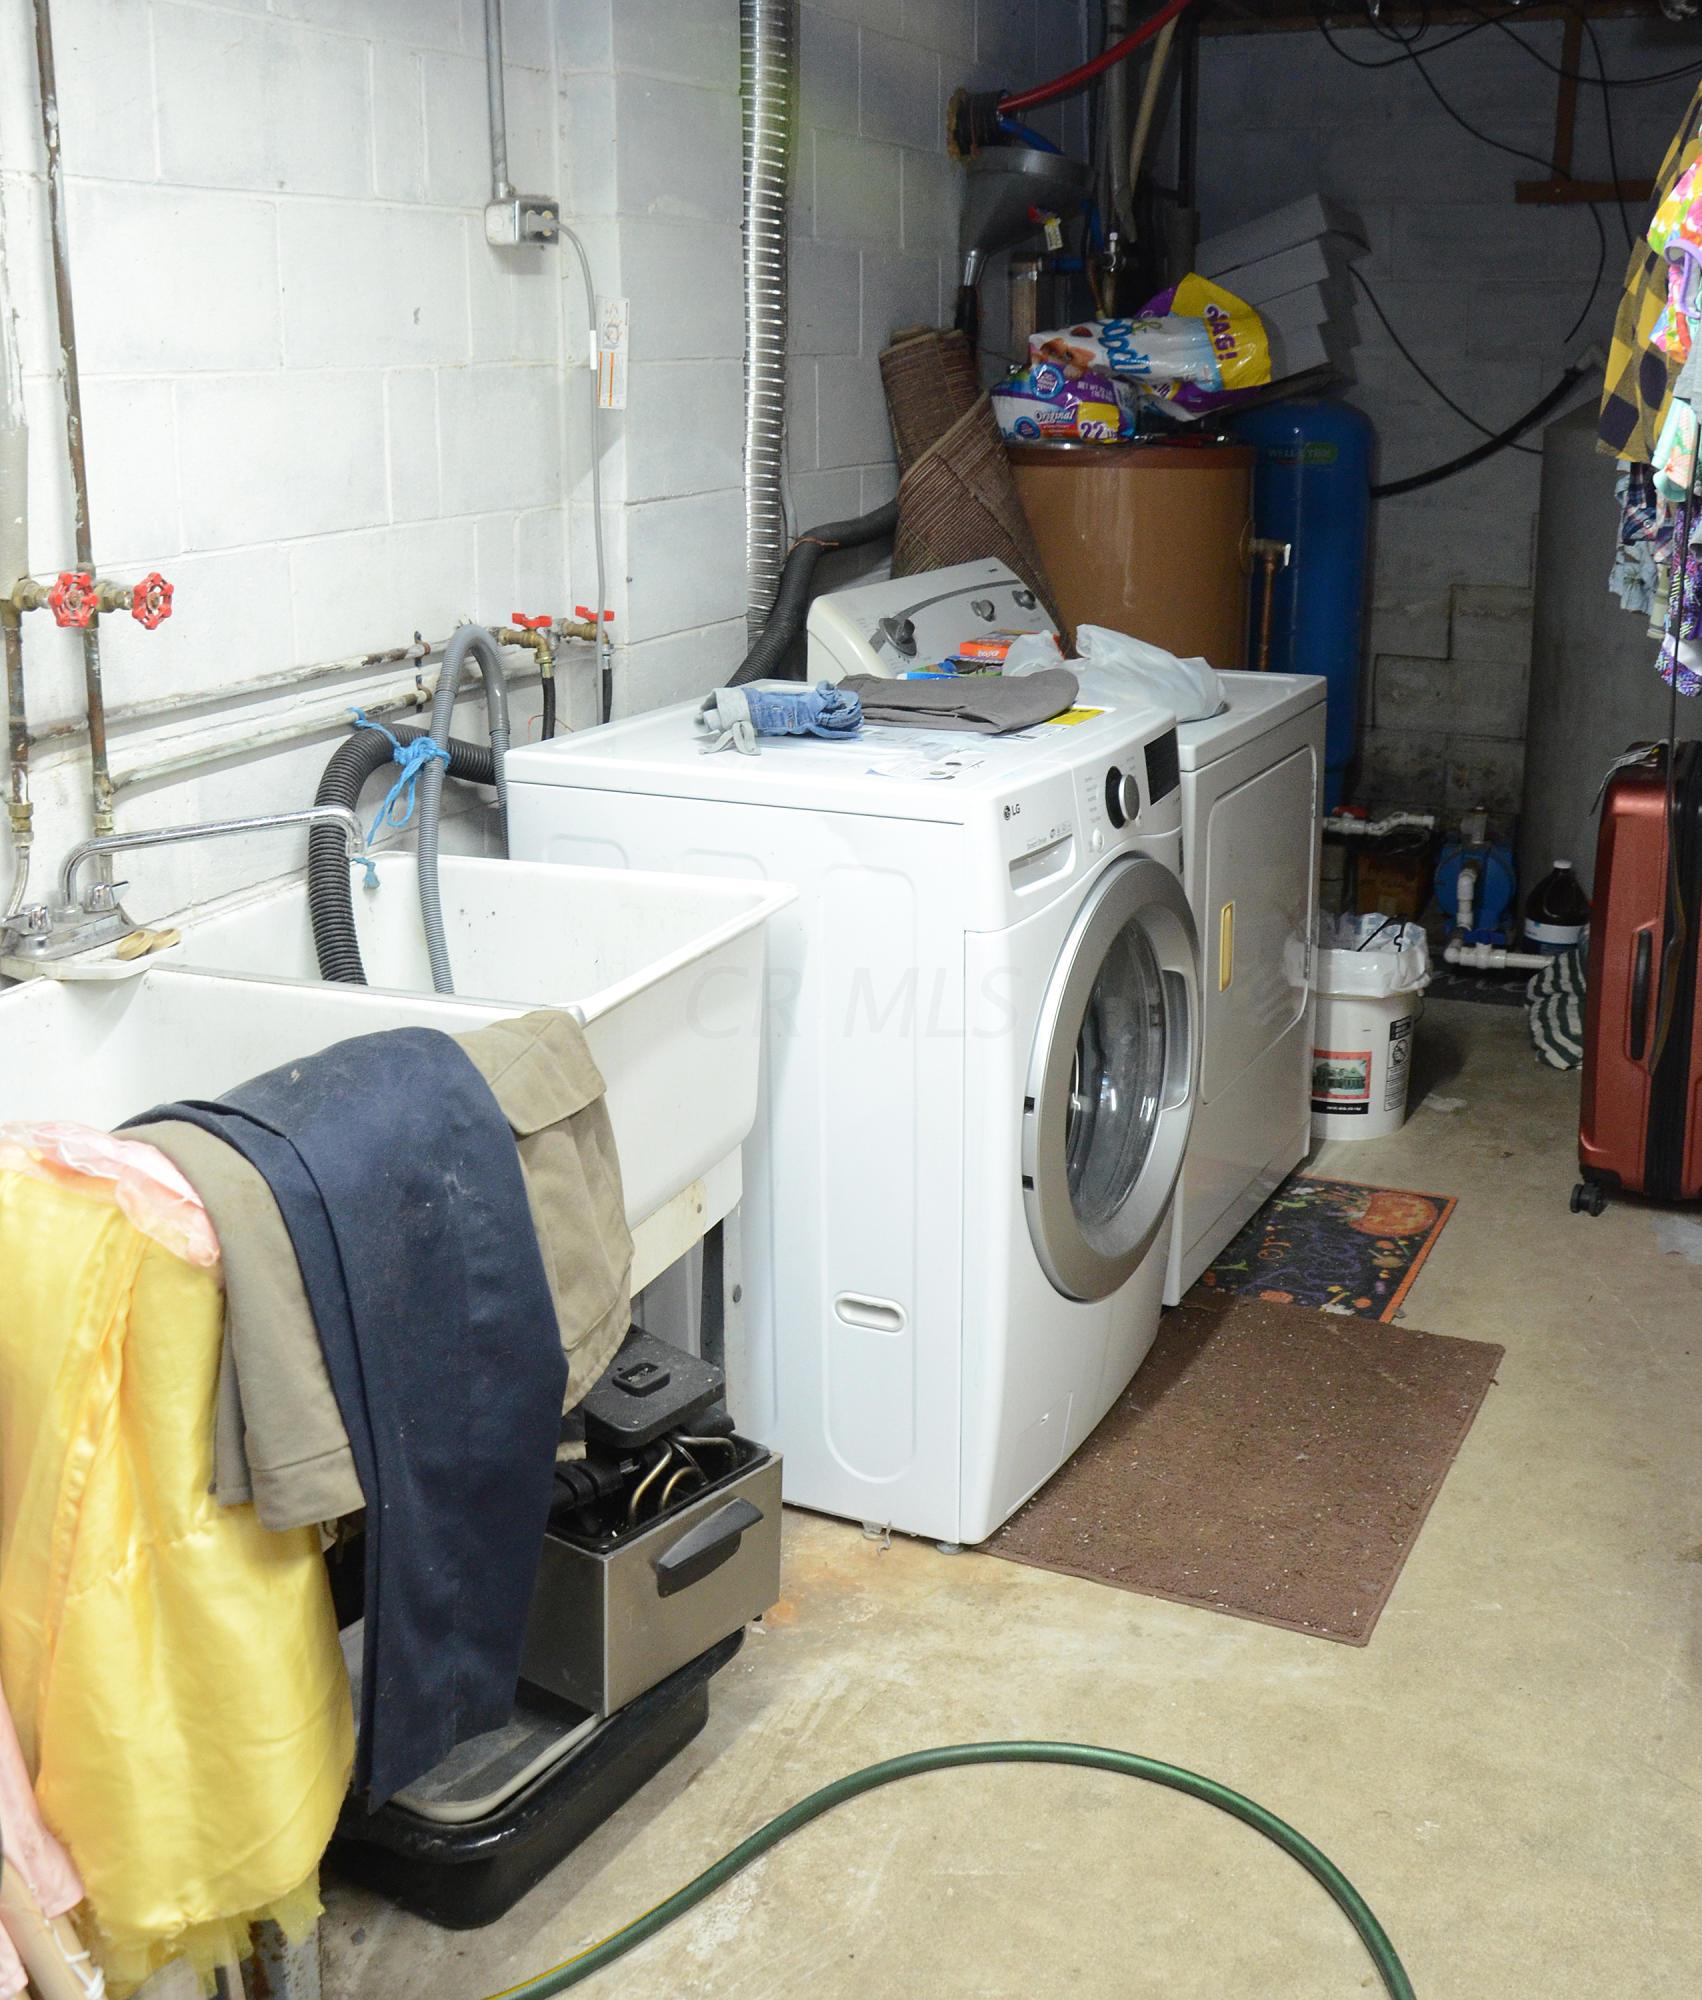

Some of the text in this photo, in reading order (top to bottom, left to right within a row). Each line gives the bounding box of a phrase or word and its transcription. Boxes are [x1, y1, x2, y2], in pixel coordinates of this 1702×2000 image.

[1034, 409, 1076, 425] Original
[1079, 421, 1104, 440] 22
[1011, 803, 1021, 816] LG
